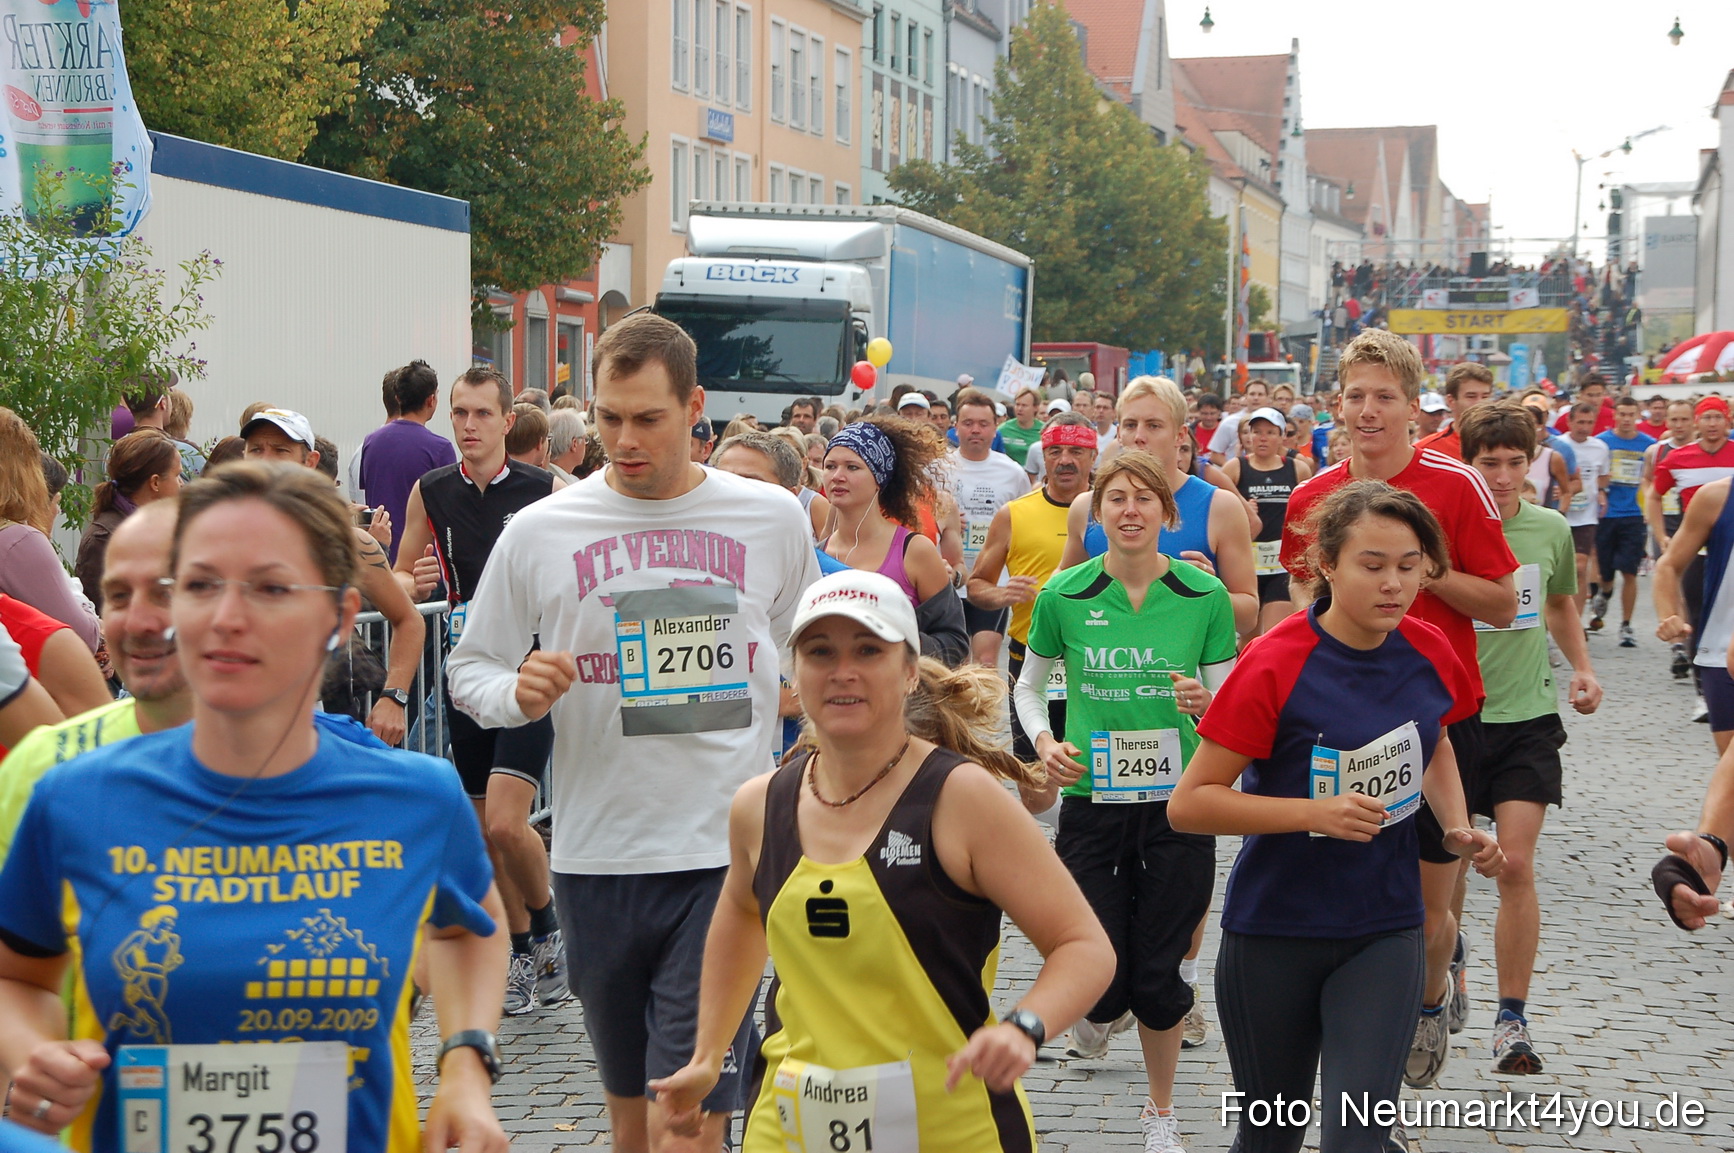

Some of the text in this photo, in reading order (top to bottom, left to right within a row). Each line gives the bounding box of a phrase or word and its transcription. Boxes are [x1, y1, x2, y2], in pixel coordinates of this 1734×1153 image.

[706, 264, 800, 284] BOCK
[1445, 314, 1506, 329] START
[573, 529, 747, 602] MT. VERNON
[809, 589, 879, 610] SPONSER
[653, 615, 731, 636] Alexander
[627, 648, 635, 662] B
[657, 642, 734, 674] 2706
[1083, 646, 1155, 670] MCM
[1047, 673, 1067, 685] 29
[701, 689, 748, 702] PFLEIDERER
[1087, 683, 1130, 697] HARTEIS
[1115, 737, 1159, 750] Theresa
[1096, 758, 1102, 767] B
[1347, 739, 1411, 773] Anna-Lena
[1117, 757, 1171, 777] 2494
[1318, 781, 1326, 793] B
[108, 840, 404, 876] 10. NEUMARKTER
[880, 844, 921, 860] BLOEMEN
[153, 870, 361, 903] STADTLAUF
[237, 1008, 379, 1032] 20.09.2009
[183, 1062, 270, 1098] Margit
[804, 1075, 868, 1104] Andrea
[135, 1110, 148, 1132] C
[187, 1110, 320, 1153] 3758
[829, 1118, 873, 1152] 81
